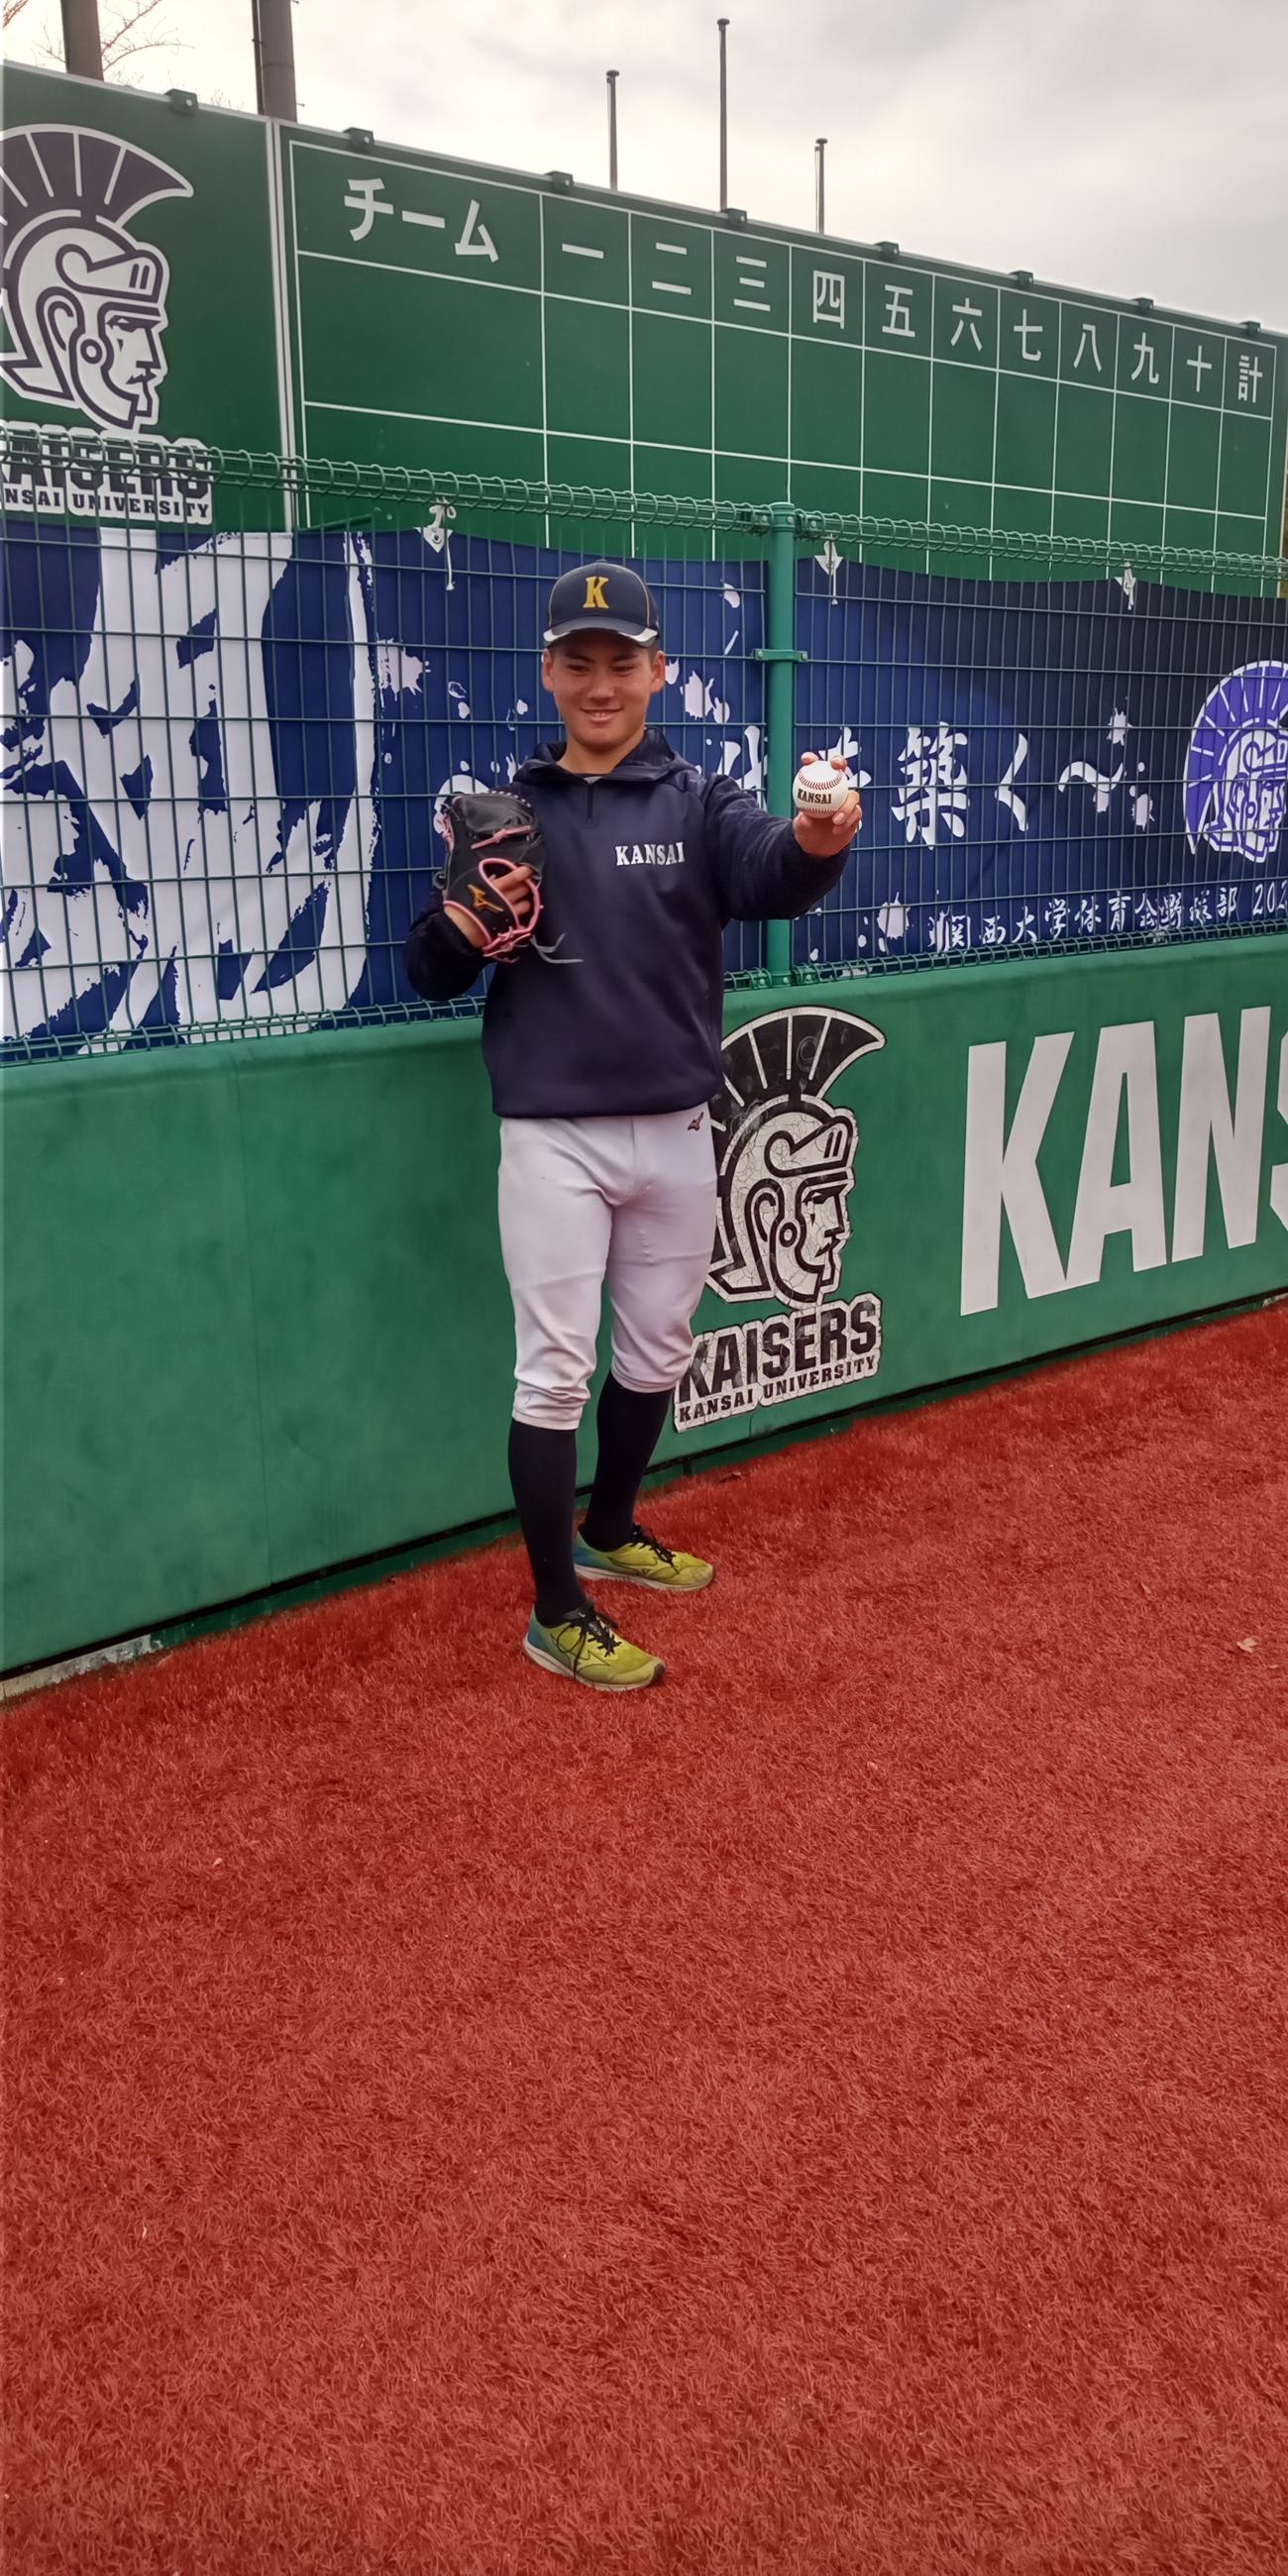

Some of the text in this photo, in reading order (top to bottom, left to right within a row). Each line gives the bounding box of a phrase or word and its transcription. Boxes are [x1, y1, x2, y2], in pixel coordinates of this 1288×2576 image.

[344, 177, 498, 263] チーム
[652, 243, 692, 294] 二
[734, 256, 770, 311] 三
[812, 270, 845, 329] 四
[882, 284, 915, 337] 五
[950, 298, 983, 352] 六
[1014, 308, 1043, 361] 七
[1073, 323, 1102, 373] 八
[1130, 332, 1159, 384] 九
[1186, 345, 1212, 391] 十
[1237, 354, 1262, 403] 計
[0, 428, 209, 498] AISERS
[73, 493, 209, 518] UNIVERSITY
[583, 576, 609, 610] K
[797, 788, 832, 805] KANSAI
[615, 841, 686, 867] KANSAI
[960, 1006, 1288, 1317] KAN
[679, 1299, 877, 1404] KAISERS
[679, 1354, 877, 1423] KANSAI UNIVERSITY
